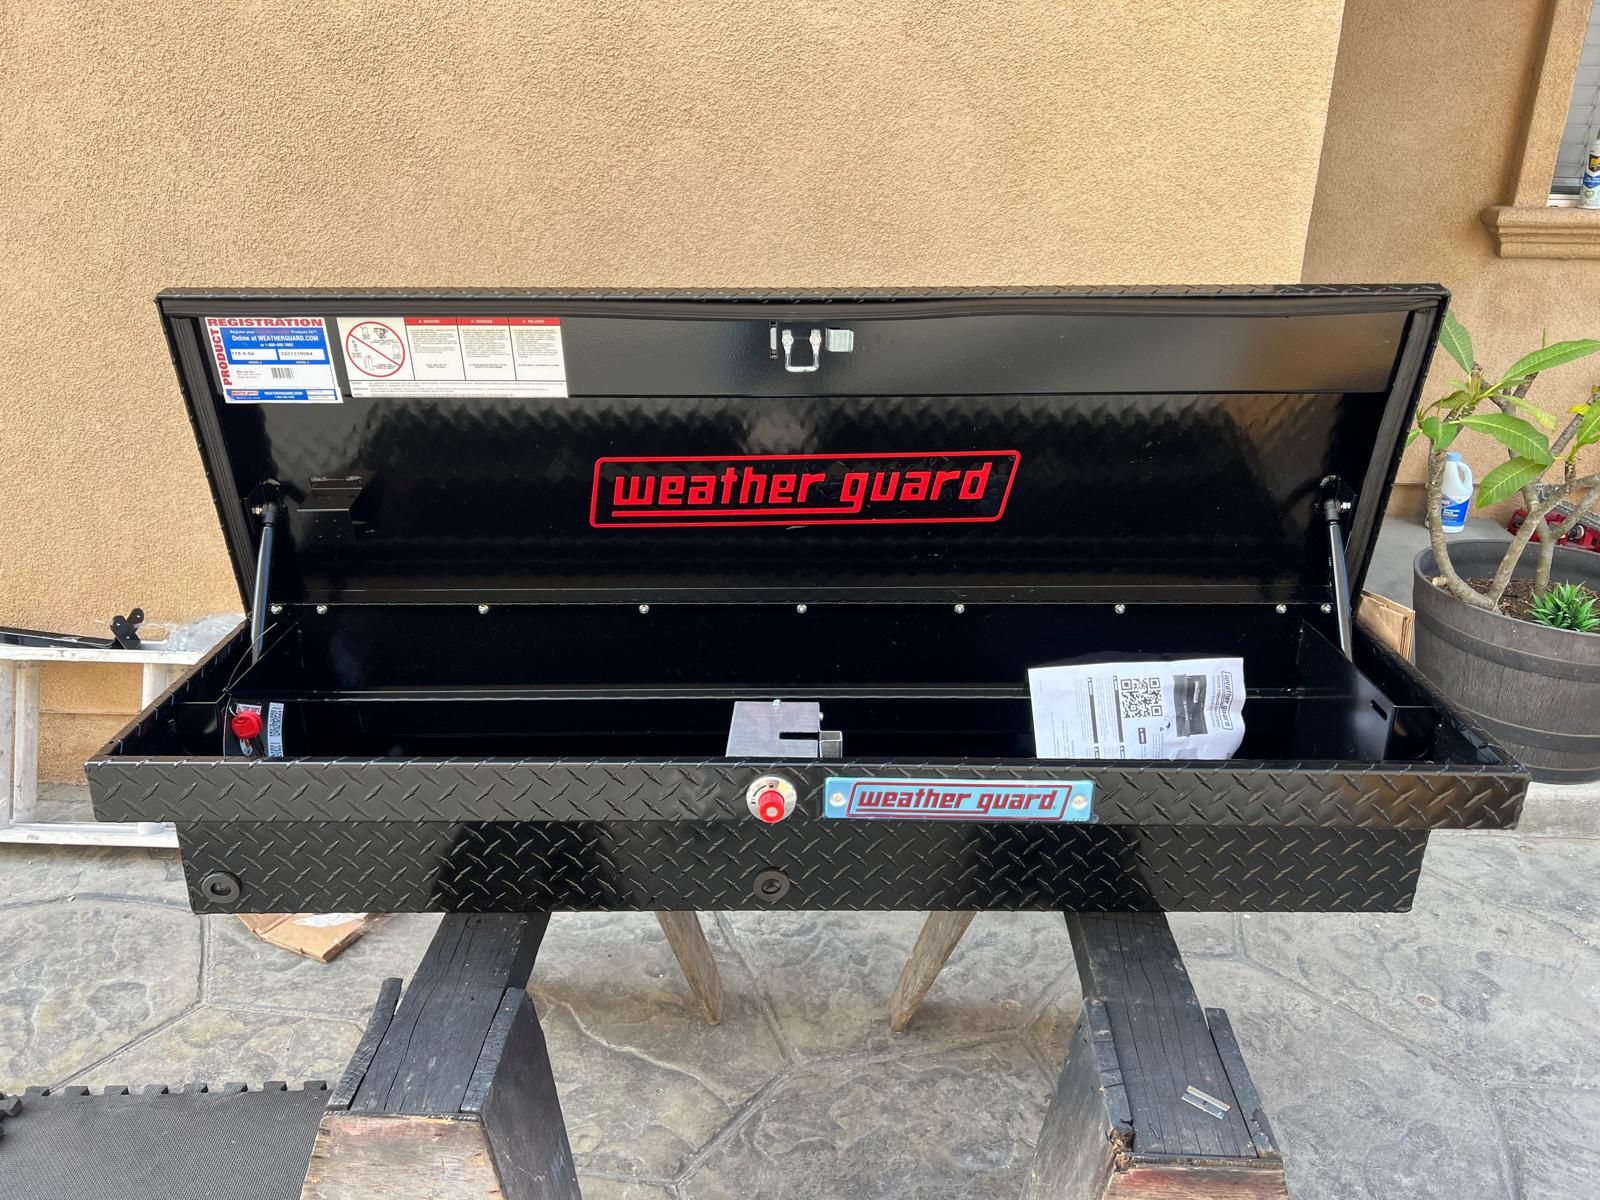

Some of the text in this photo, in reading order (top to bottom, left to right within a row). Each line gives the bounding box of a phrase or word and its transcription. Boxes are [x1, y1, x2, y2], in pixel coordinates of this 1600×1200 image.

[207, 318, 323, 327] REGISTRATION
[210, 328, 233, 386] PRODUCT
[613, 462, 993, 513] weather guard
[1220, 674, 1232, 727] weather guard
[858, 788, 1058, 814] weather guard
